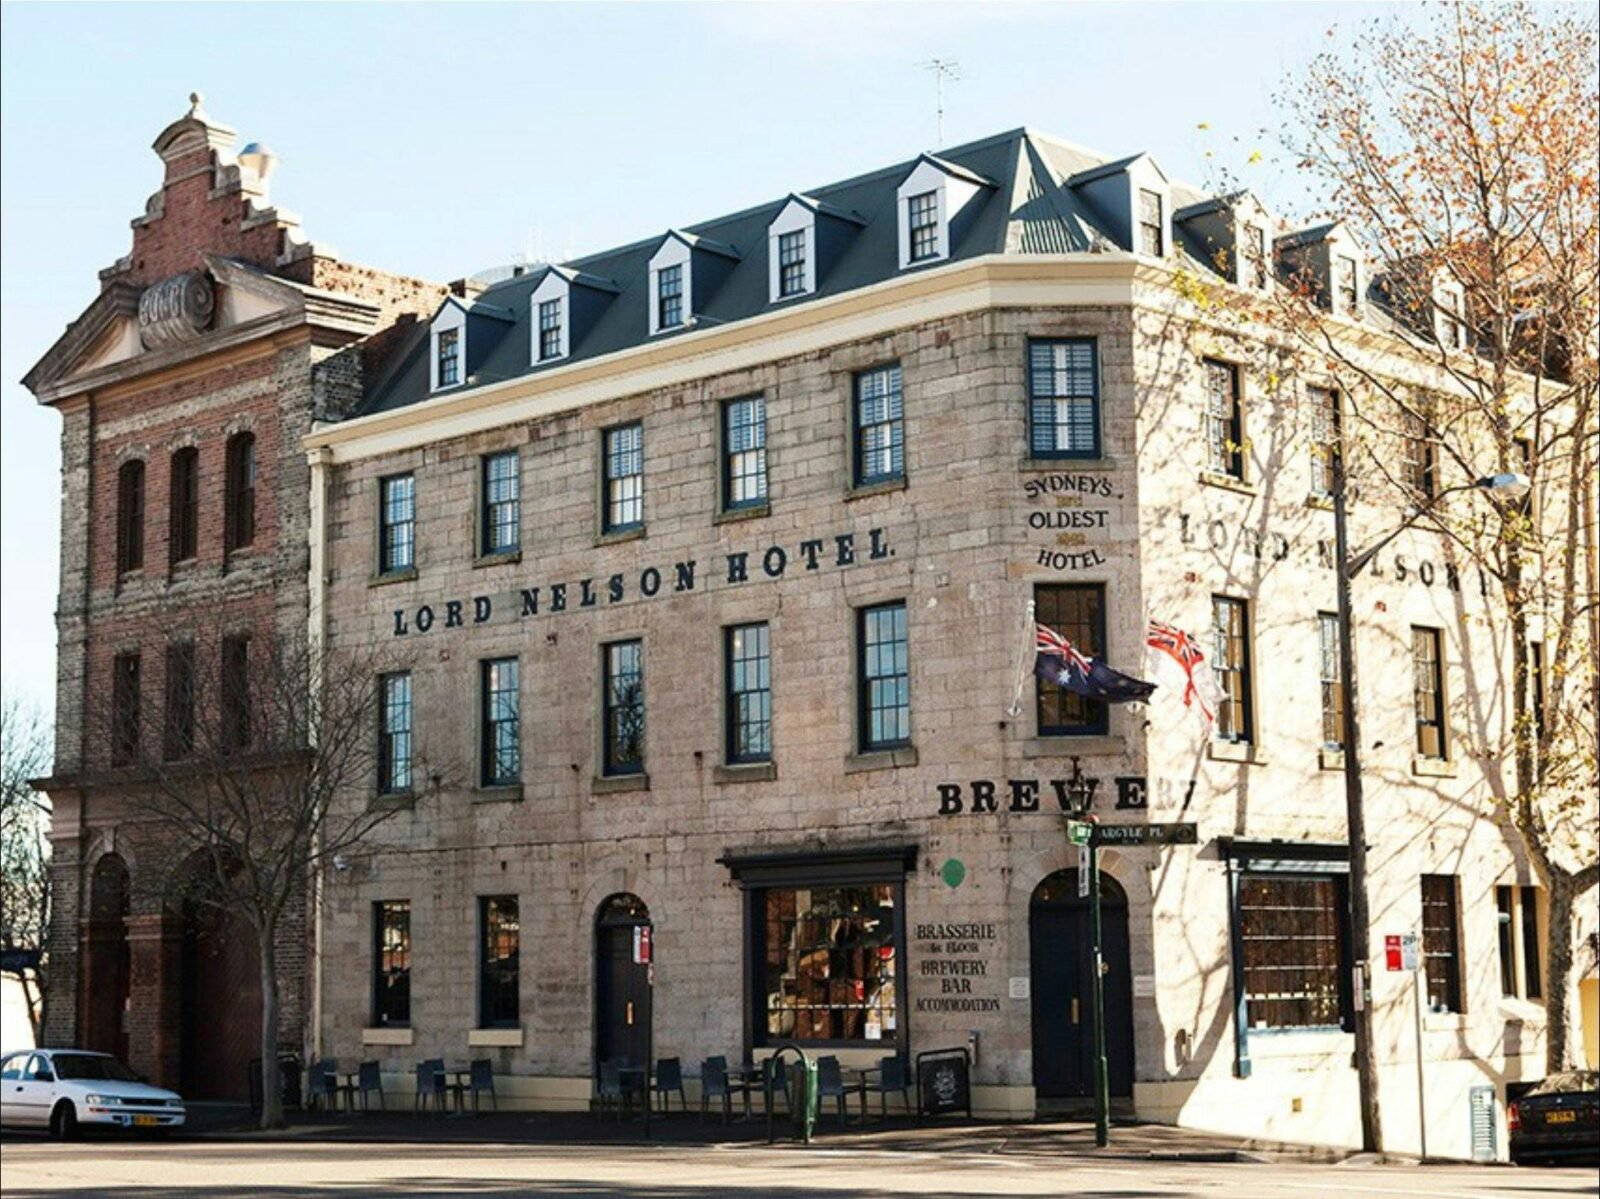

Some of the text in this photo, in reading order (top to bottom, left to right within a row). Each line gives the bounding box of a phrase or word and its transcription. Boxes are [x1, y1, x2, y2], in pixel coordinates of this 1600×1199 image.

[1024, 475, 1113, 498] SYDNEY'S
[1029, 510, 1109, 529] OLDEST
[1037, 549, 1106, 570] HOTEL
[1178, 512, 1290, 562] LORD
[1316, 539, 1461, 593] NLSON
[394, 596, 492, 636] LORD
[520, 560, 697, 617] NELSON
[1101, 827, 1143, 839] ARGYLE
[1149, 827, 1164, 838] PL
[917, 924, 996, 939] BRASSERIE
[921, 961, 988, 976] BREWERY
[942, 979, 972, 994] BAR
